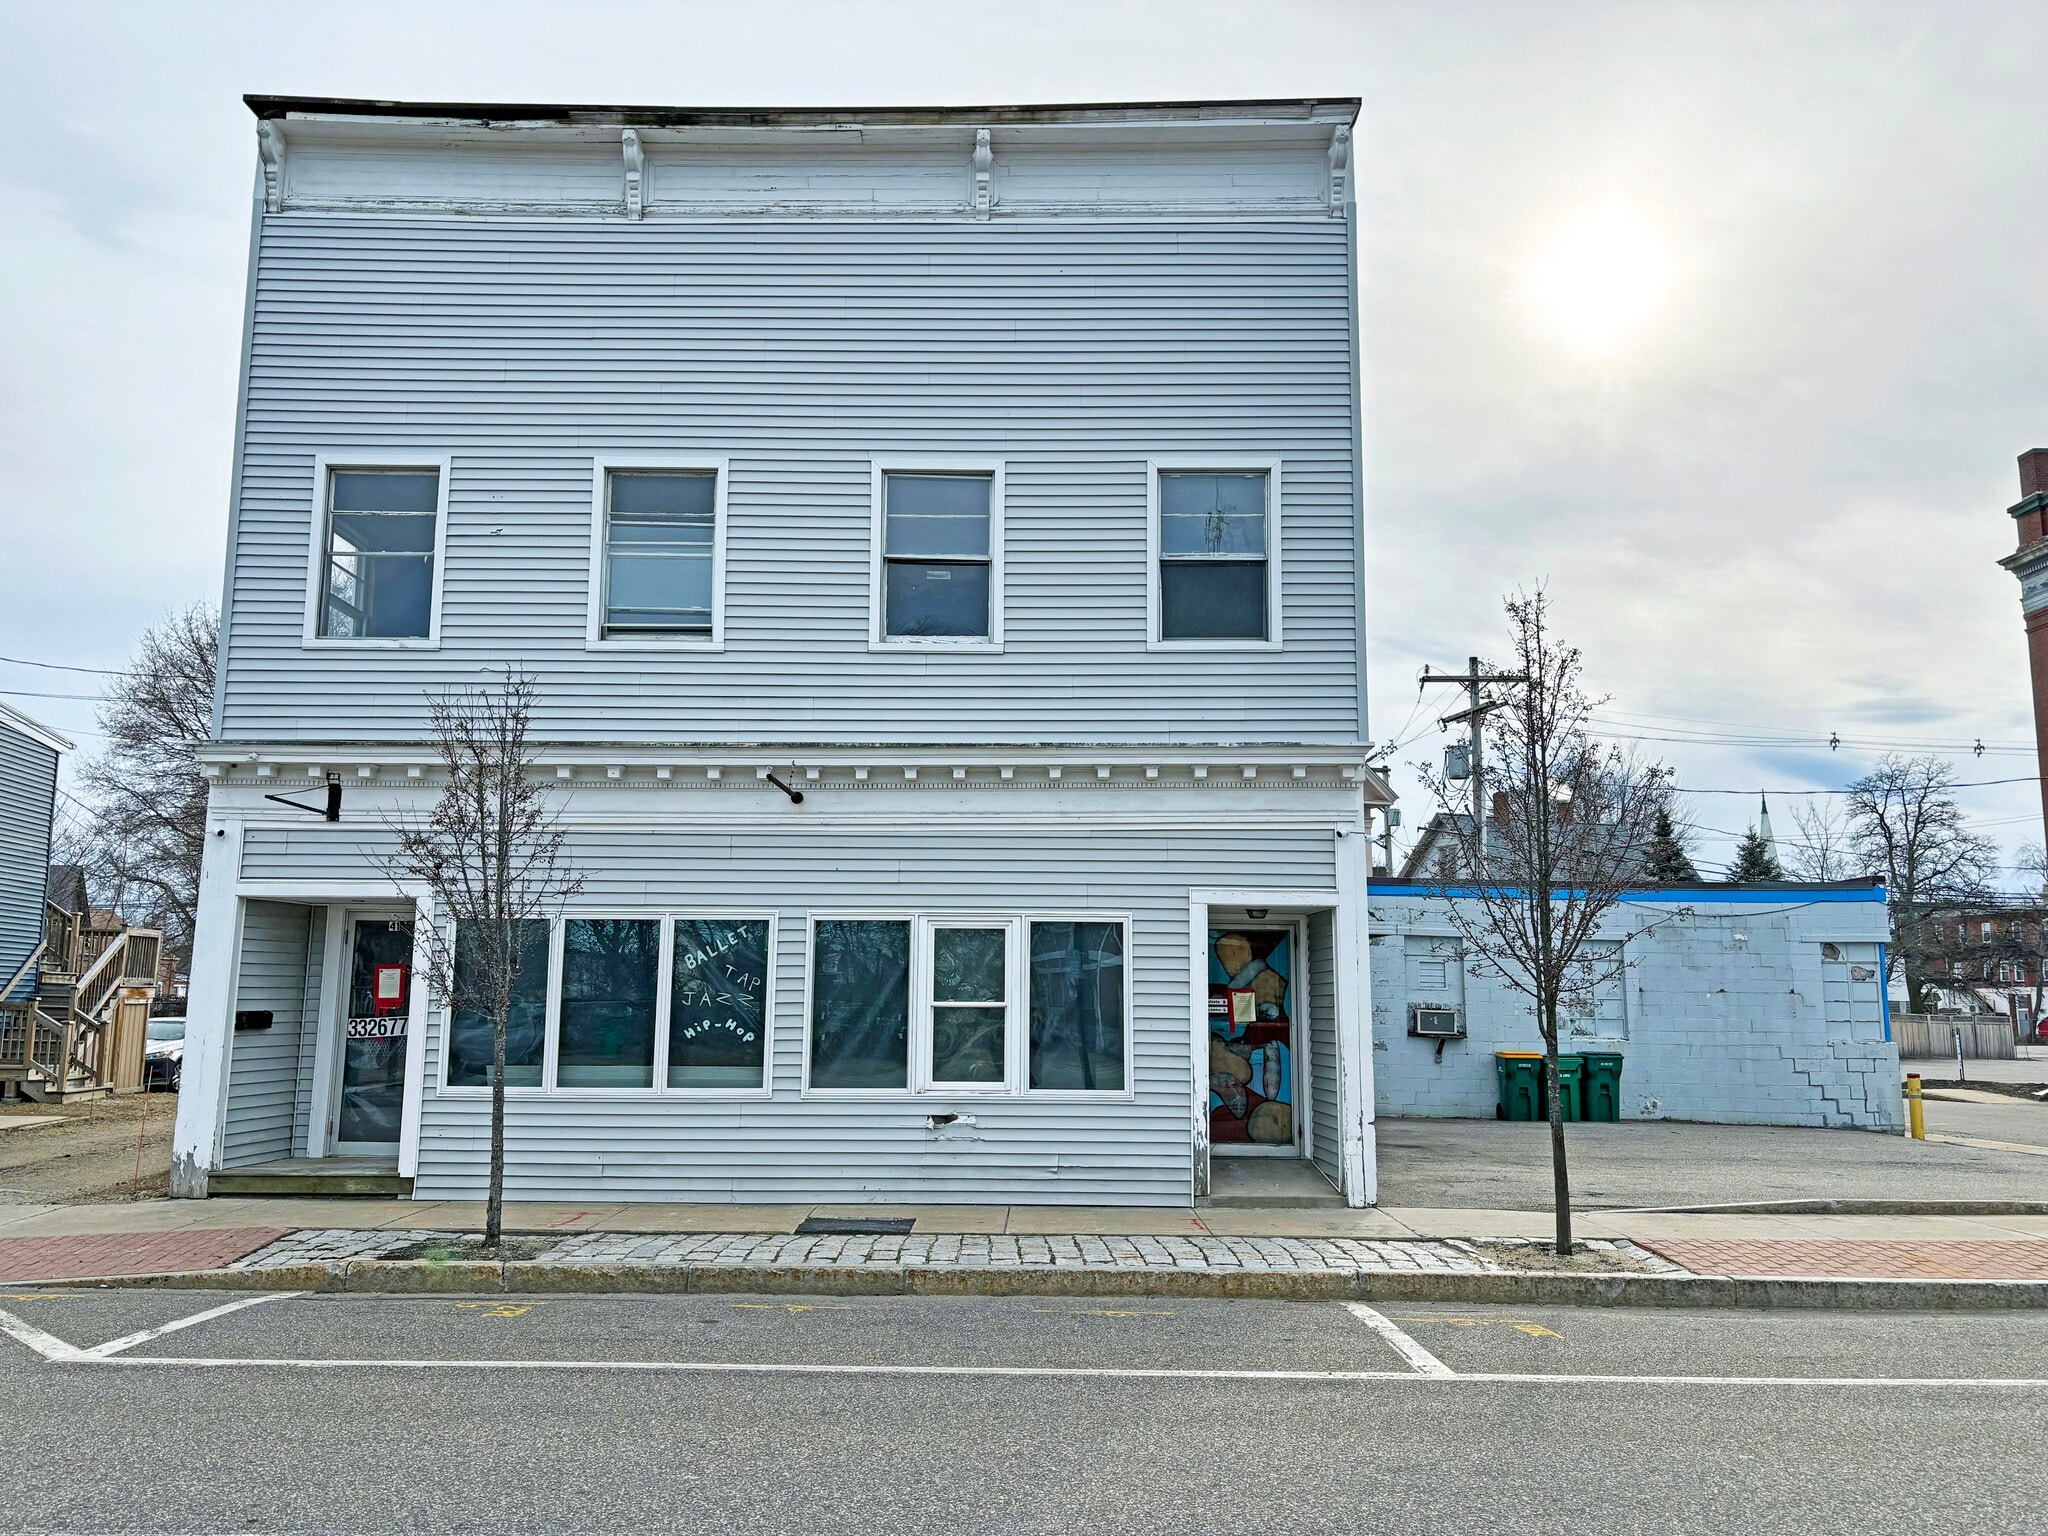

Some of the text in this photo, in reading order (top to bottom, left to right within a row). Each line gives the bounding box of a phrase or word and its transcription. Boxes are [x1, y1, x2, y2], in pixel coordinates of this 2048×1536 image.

[684, 925, 748, 970] BALLET
[725, 964, 761, 991] TAP
[681, 991, 754, 1008] JAZZ
[348, 1017, 408, 1037] 332677
